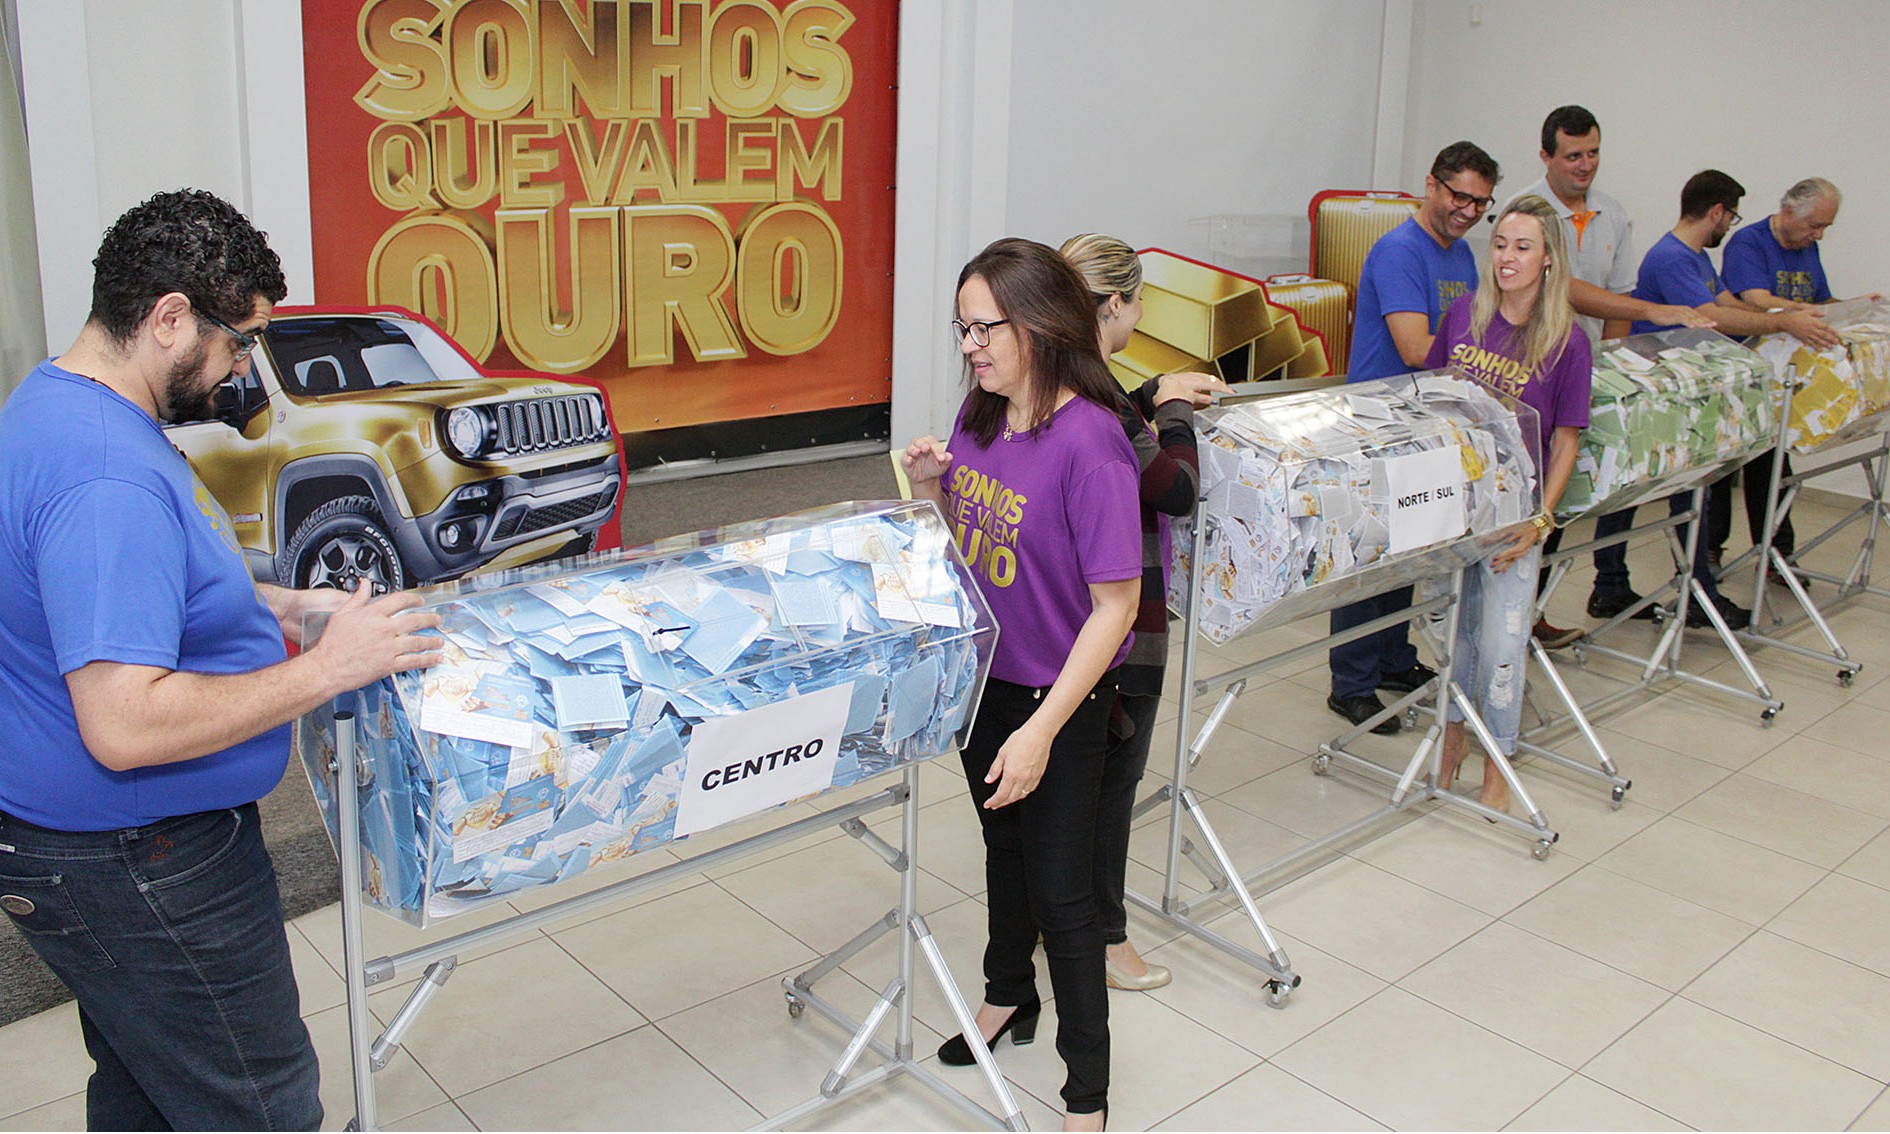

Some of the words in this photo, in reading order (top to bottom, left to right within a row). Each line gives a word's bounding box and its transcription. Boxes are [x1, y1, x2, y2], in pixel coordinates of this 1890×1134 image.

[353, 0, 855, 121] SONHOS
[367, 200, 844, 374] OURO
[1451, 343, 1531, 386] SONHOS
[1397, 491, 1430, 510] NORTE
[1436, 485, 1455, 500] SUL
[701, 738, 824, 791] CENTRO
